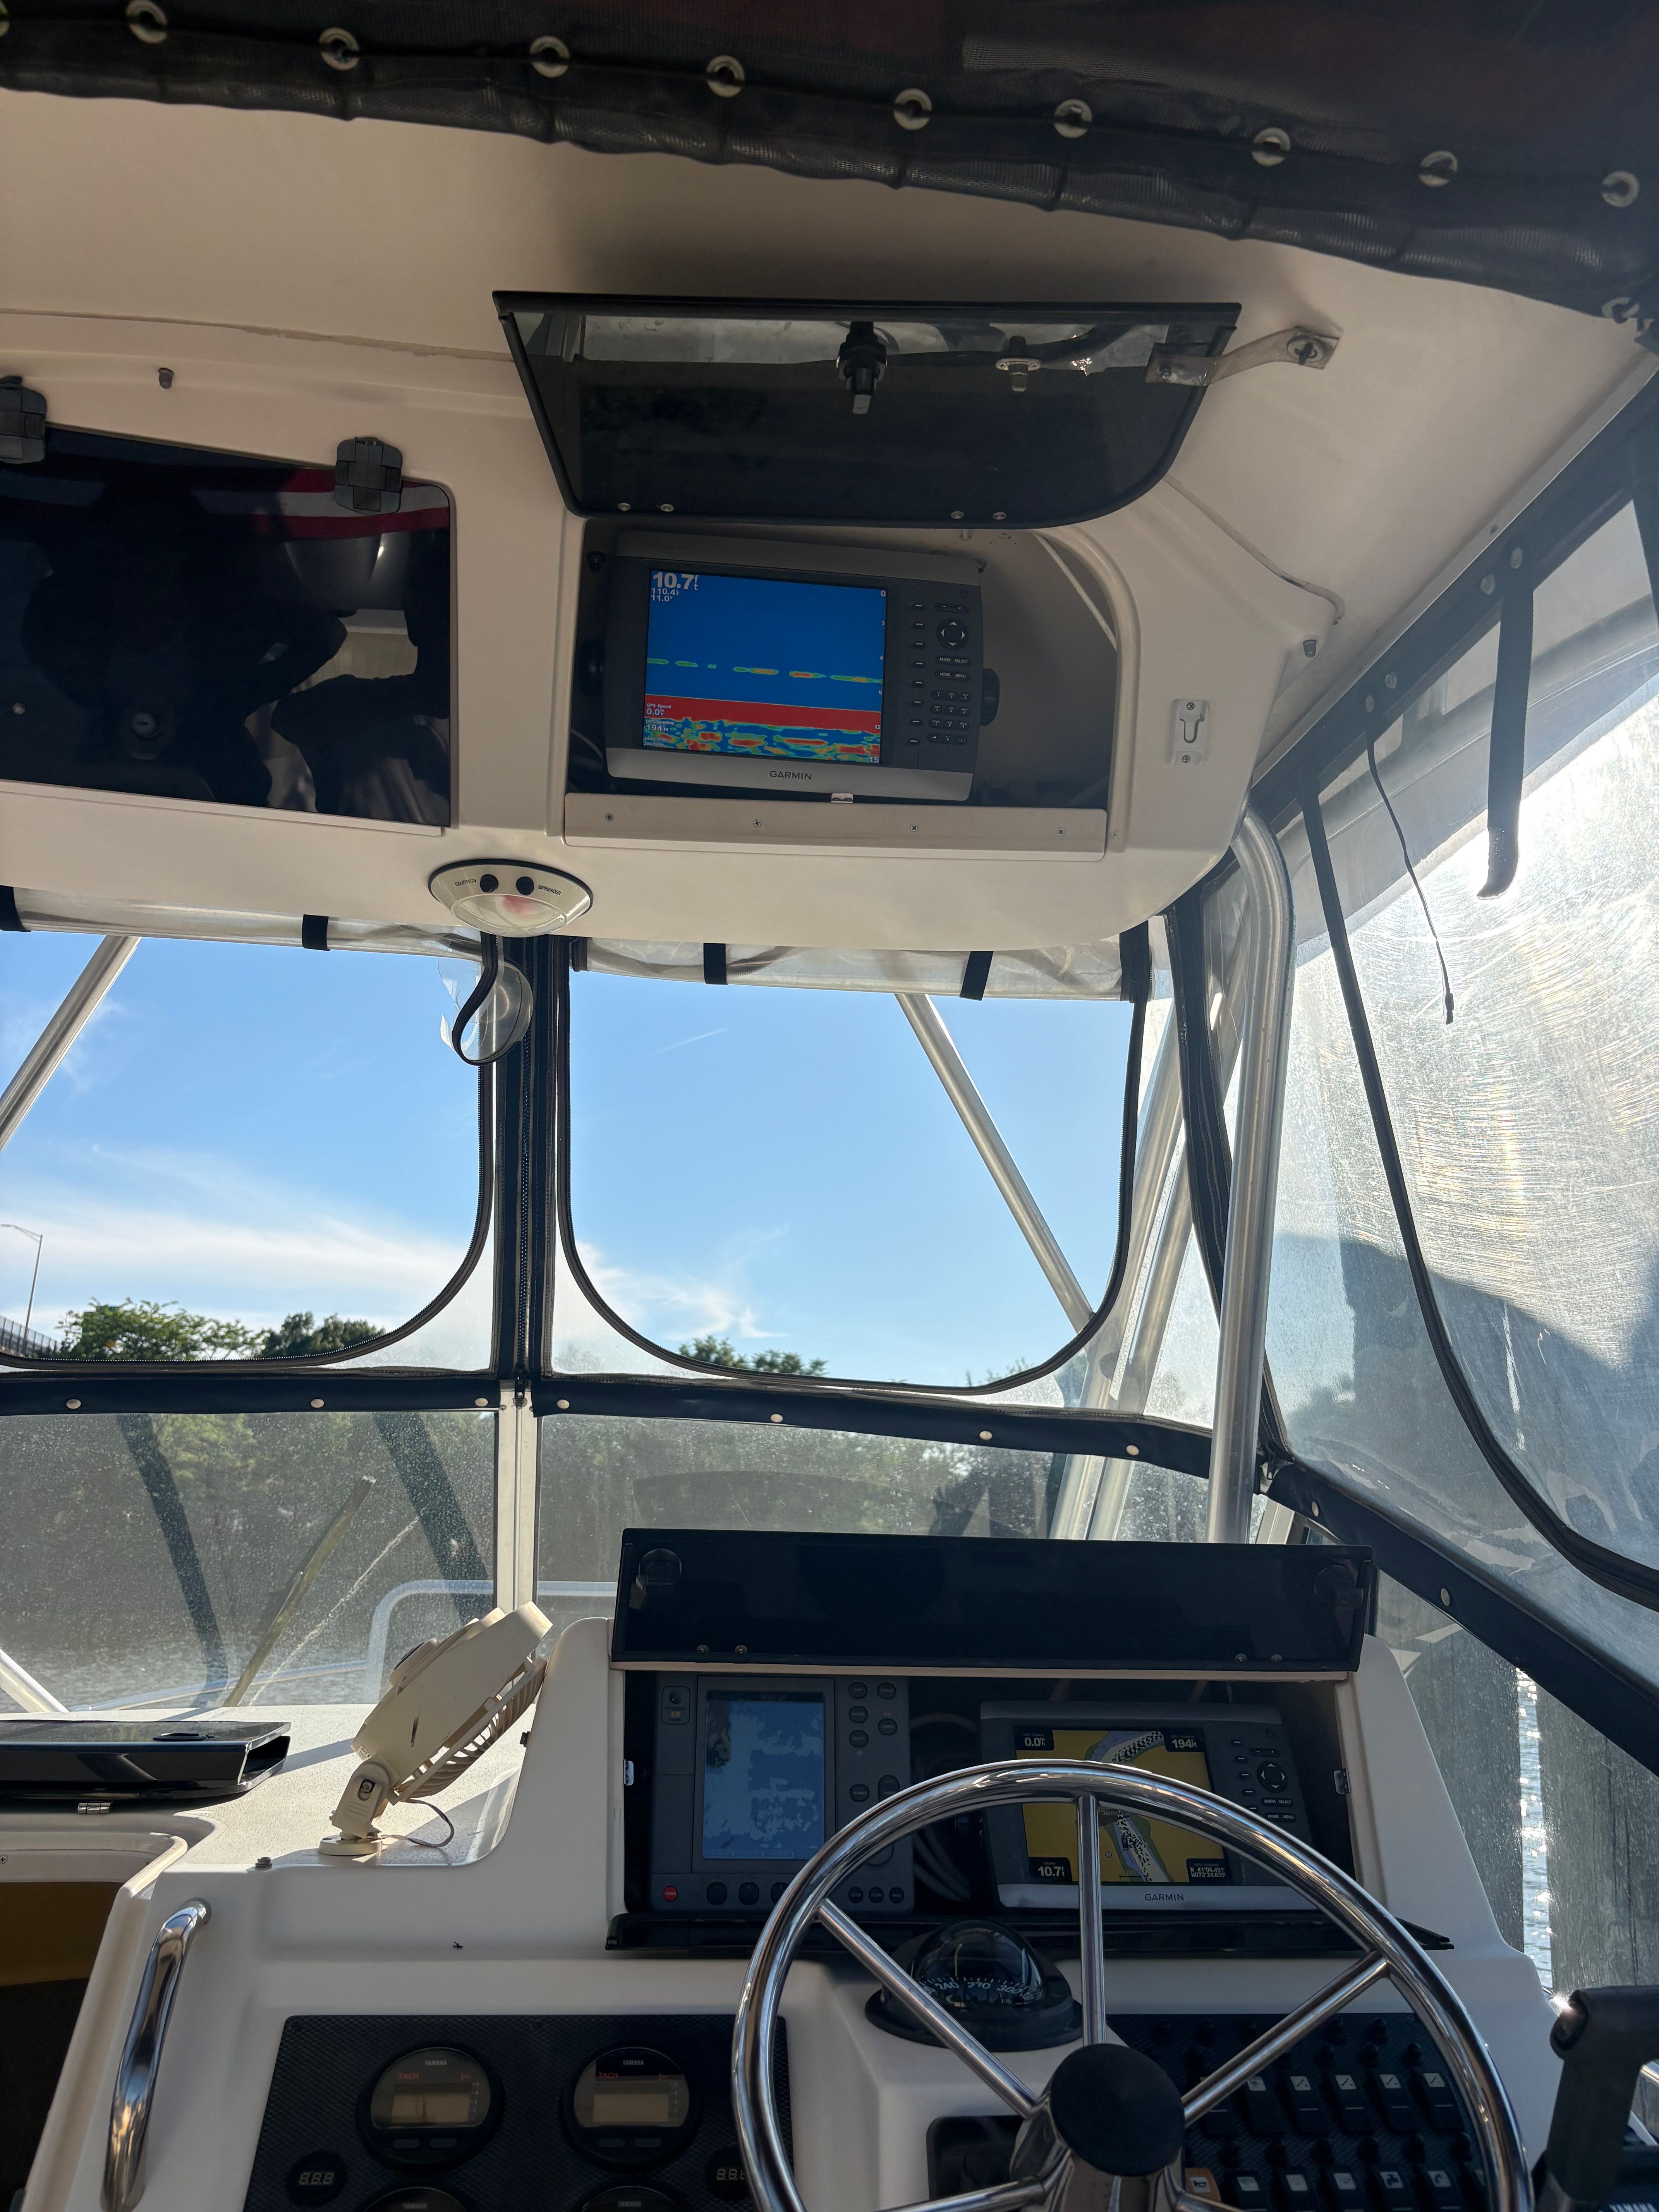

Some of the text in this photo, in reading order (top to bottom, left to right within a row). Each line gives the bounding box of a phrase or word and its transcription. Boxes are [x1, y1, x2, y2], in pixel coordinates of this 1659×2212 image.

[769, 770, 812, 780] GARMIN
[455, 878, 477, 887] COURTESY
[538, 885, 562, 896] SPREADER
[1171, 1738, 1192, 1748] 194
[1038, 1866, 1061, 1877] 10.7
[934, 1982, 960, 1990] 240
[997, 1985, 1023, 1994] 300
